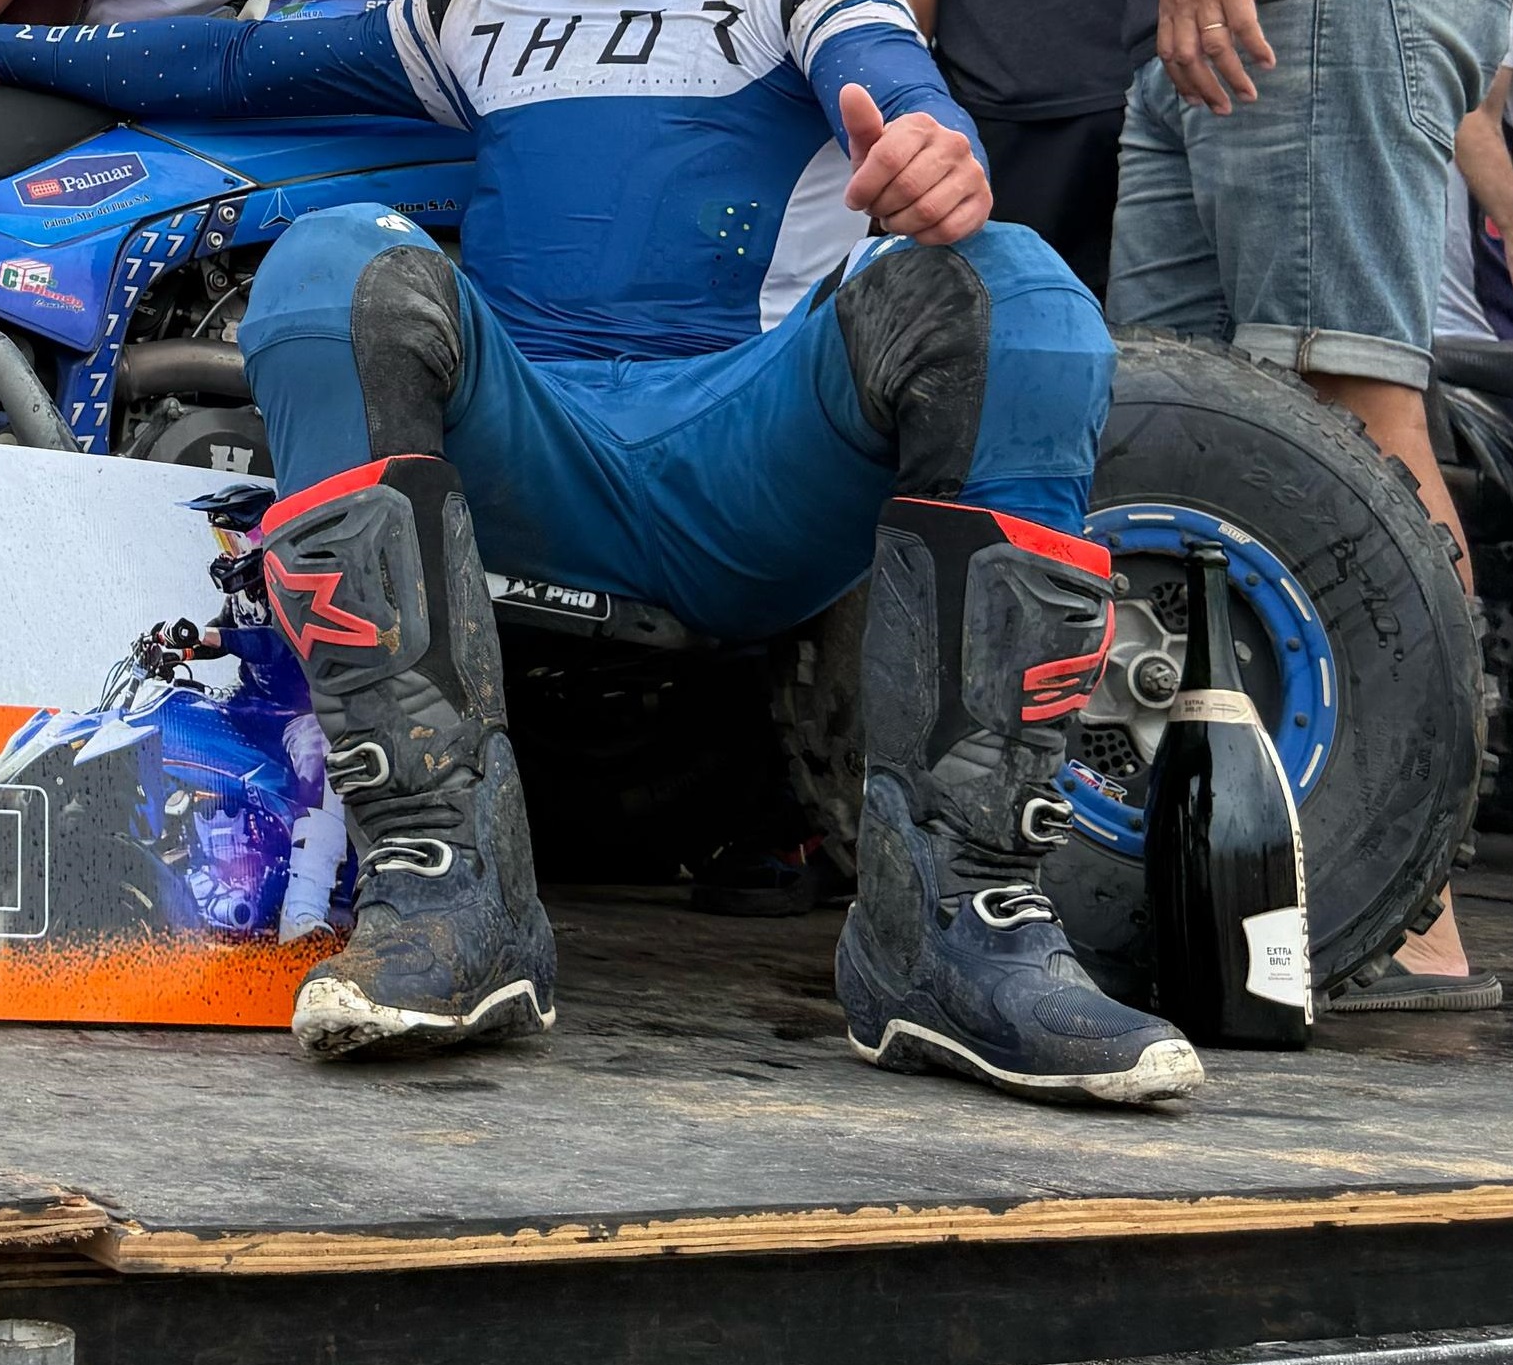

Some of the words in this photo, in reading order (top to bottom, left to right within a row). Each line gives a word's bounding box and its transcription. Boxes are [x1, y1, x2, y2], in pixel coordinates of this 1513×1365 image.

[471, 0, 746, 88] THOR
[60, 164, 133, 193] Palmar
[544, 585, 597, 609] PRO
[1266, 946, 1292, 956] EXTRA
[1269, 956, 1291, 966] BRUT
